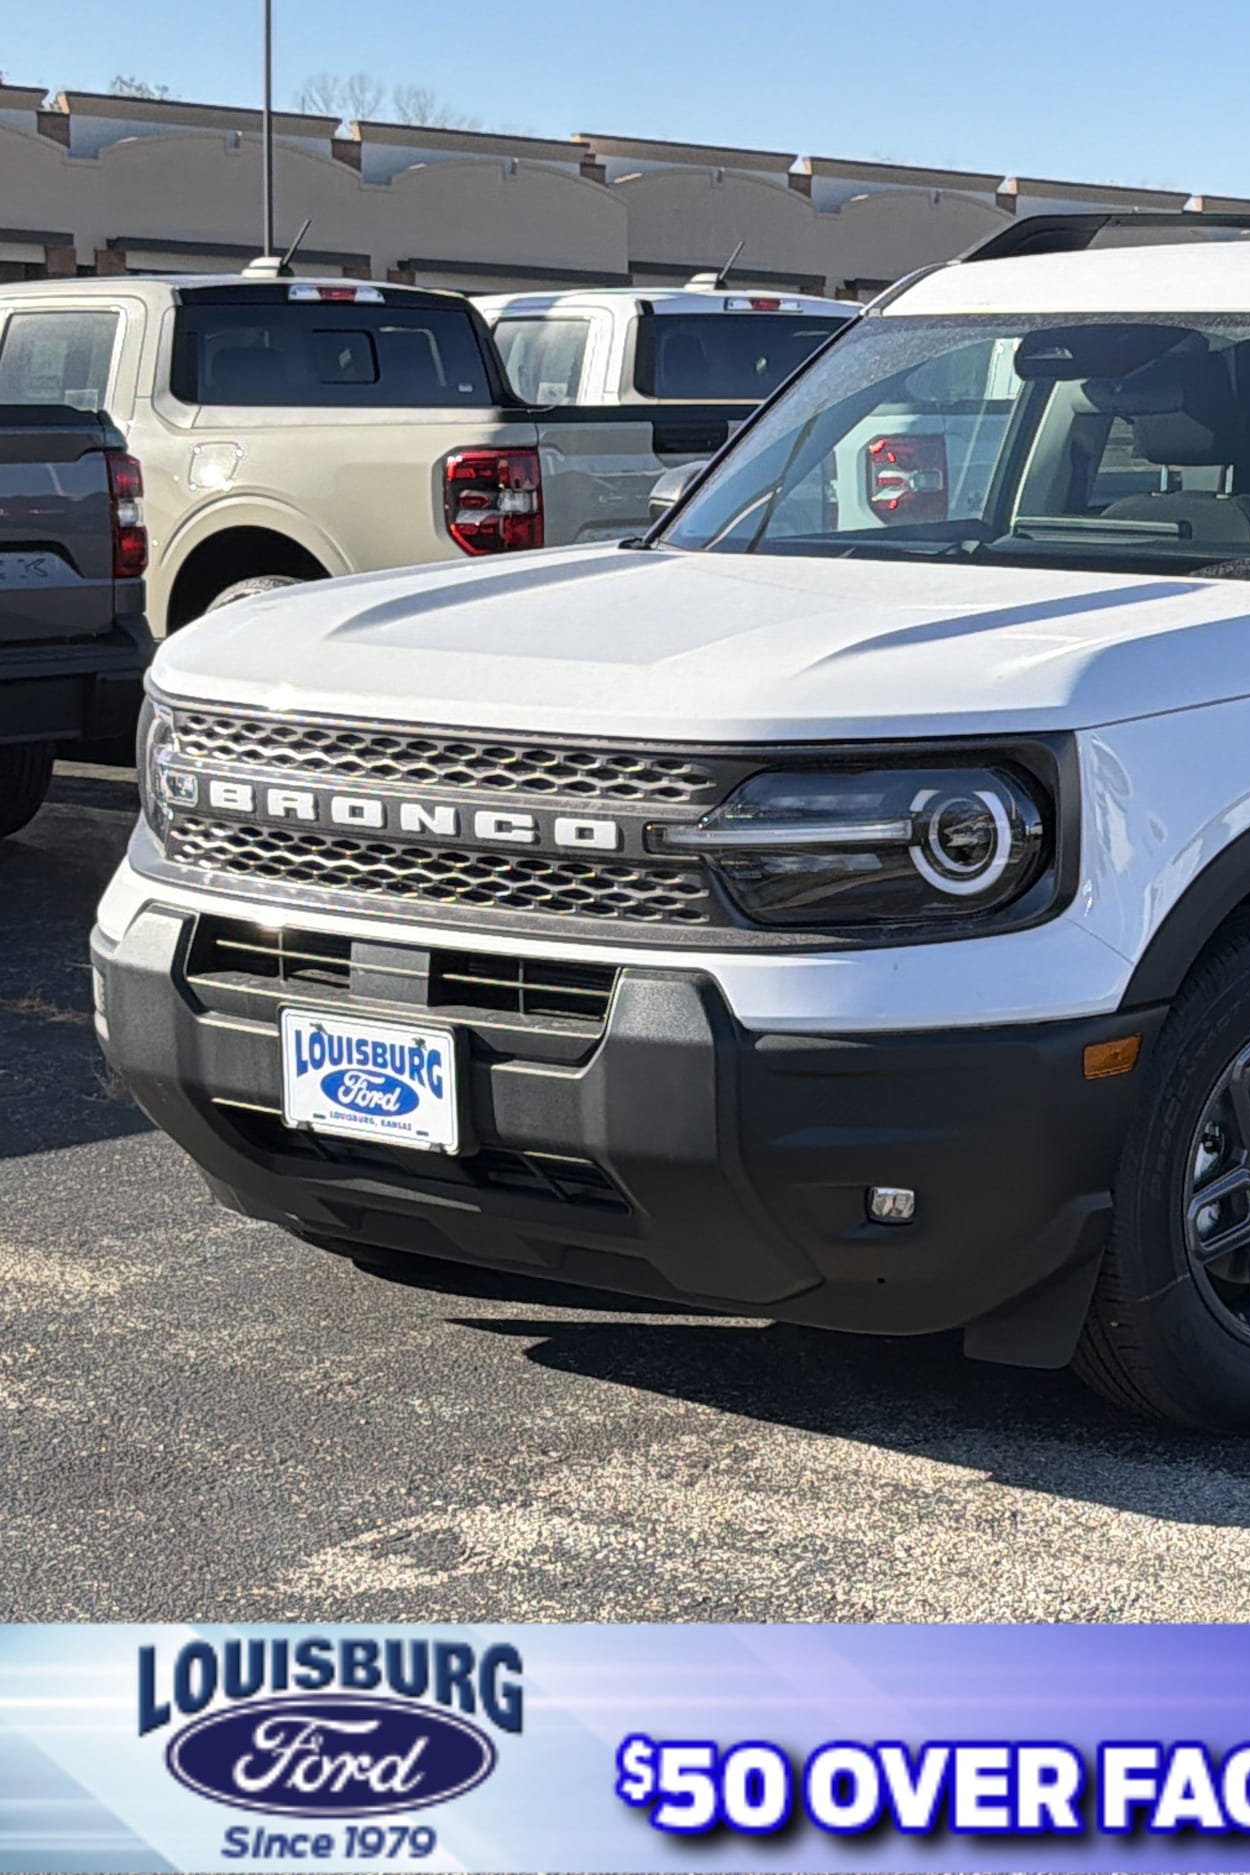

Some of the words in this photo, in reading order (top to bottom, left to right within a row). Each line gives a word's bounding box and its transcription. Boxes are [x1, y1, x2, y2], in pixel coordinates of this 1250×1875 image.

[209, 780, 620, 850] BRONCO
[295, 1029, 443, 1099] LOUISBURG
[337, 1070, 402, 1111] Ford
[380, 1119, 412, 1131] KANSAS
